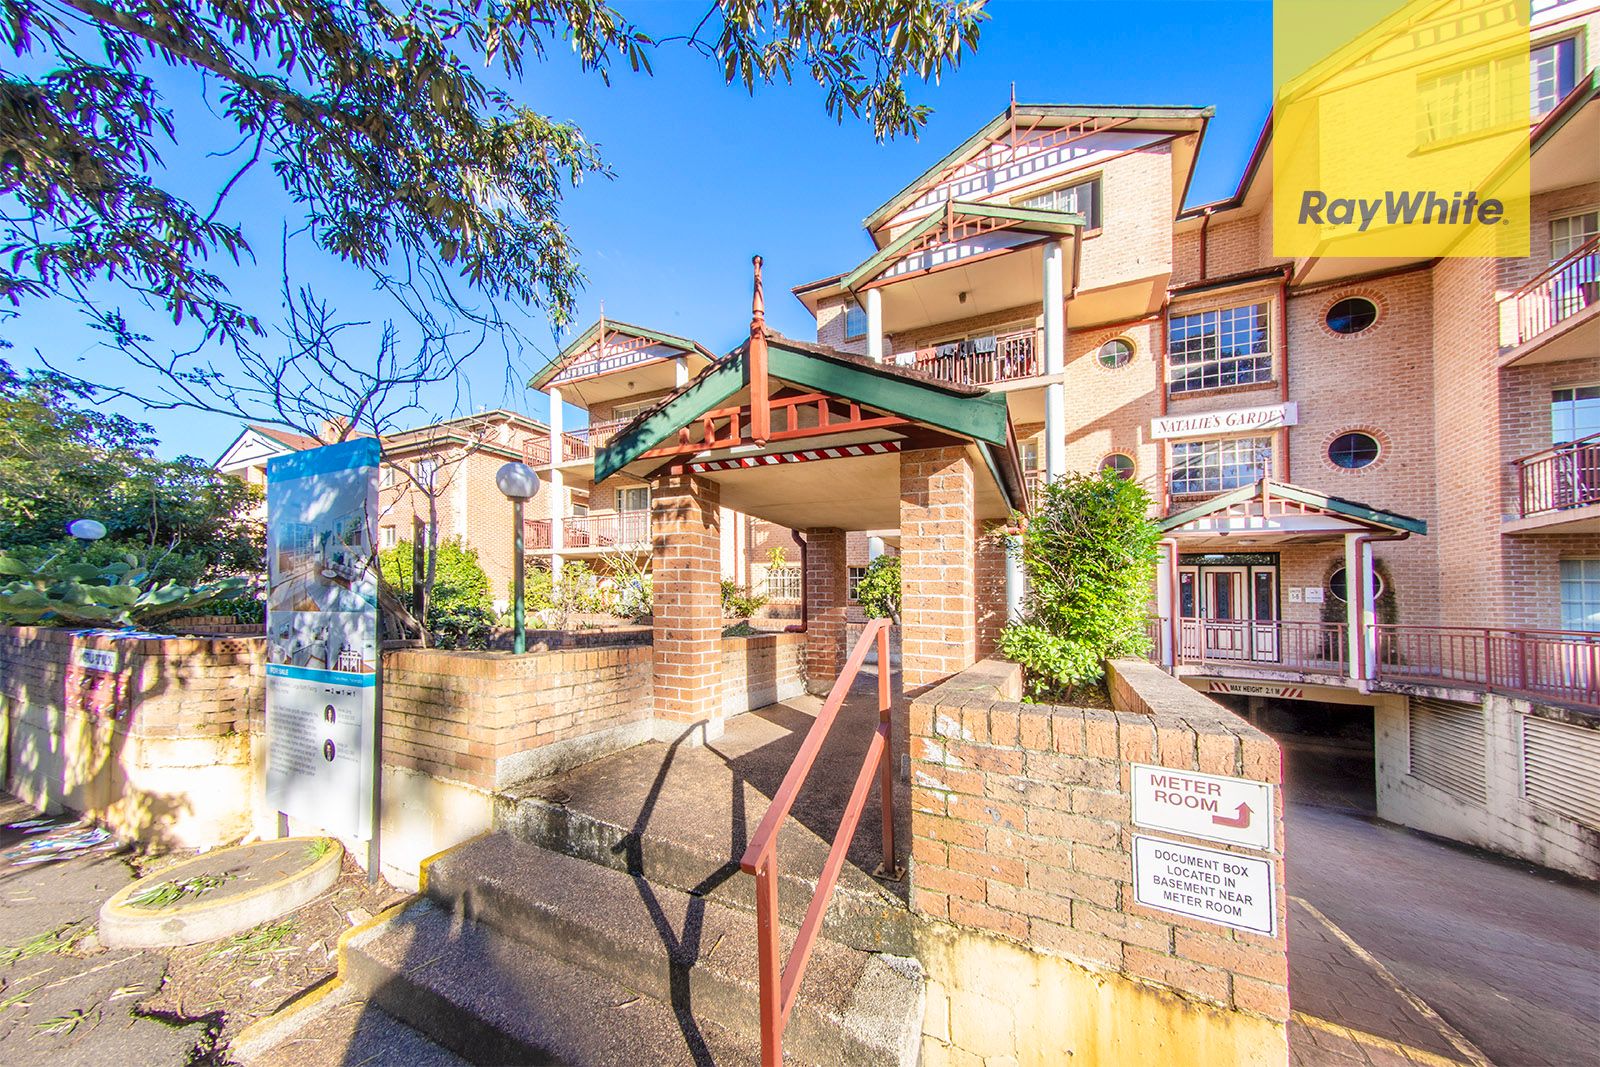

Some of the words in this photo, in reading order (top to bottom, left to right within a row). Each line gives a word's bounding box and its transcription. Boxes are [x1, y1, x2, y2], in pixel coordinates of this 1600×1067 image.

[1158, 414, 1221, 433] NATALIE'S
[1226, 408, 1287, 426] GARDEN
[1243, 685, 1263, 693] HEIGHT
[1150, 774, 1222, 797] METER
[1154, 790, 1218, 813] ROOM
[1154, 849, 1220, 871] DOCUMENT
[1223, 863, 1249, 877] BOX
[1167, 865, 1221, 885] LOCATED
[1224, 877, 1236, 888] IN
[1153, 875, 1216, 897] BASEMENT
[1219, 889, 1253, 906] NEAR
[1163, 890, 1202, 908] METER
[1206, 900, 1242, 917] ROOM
